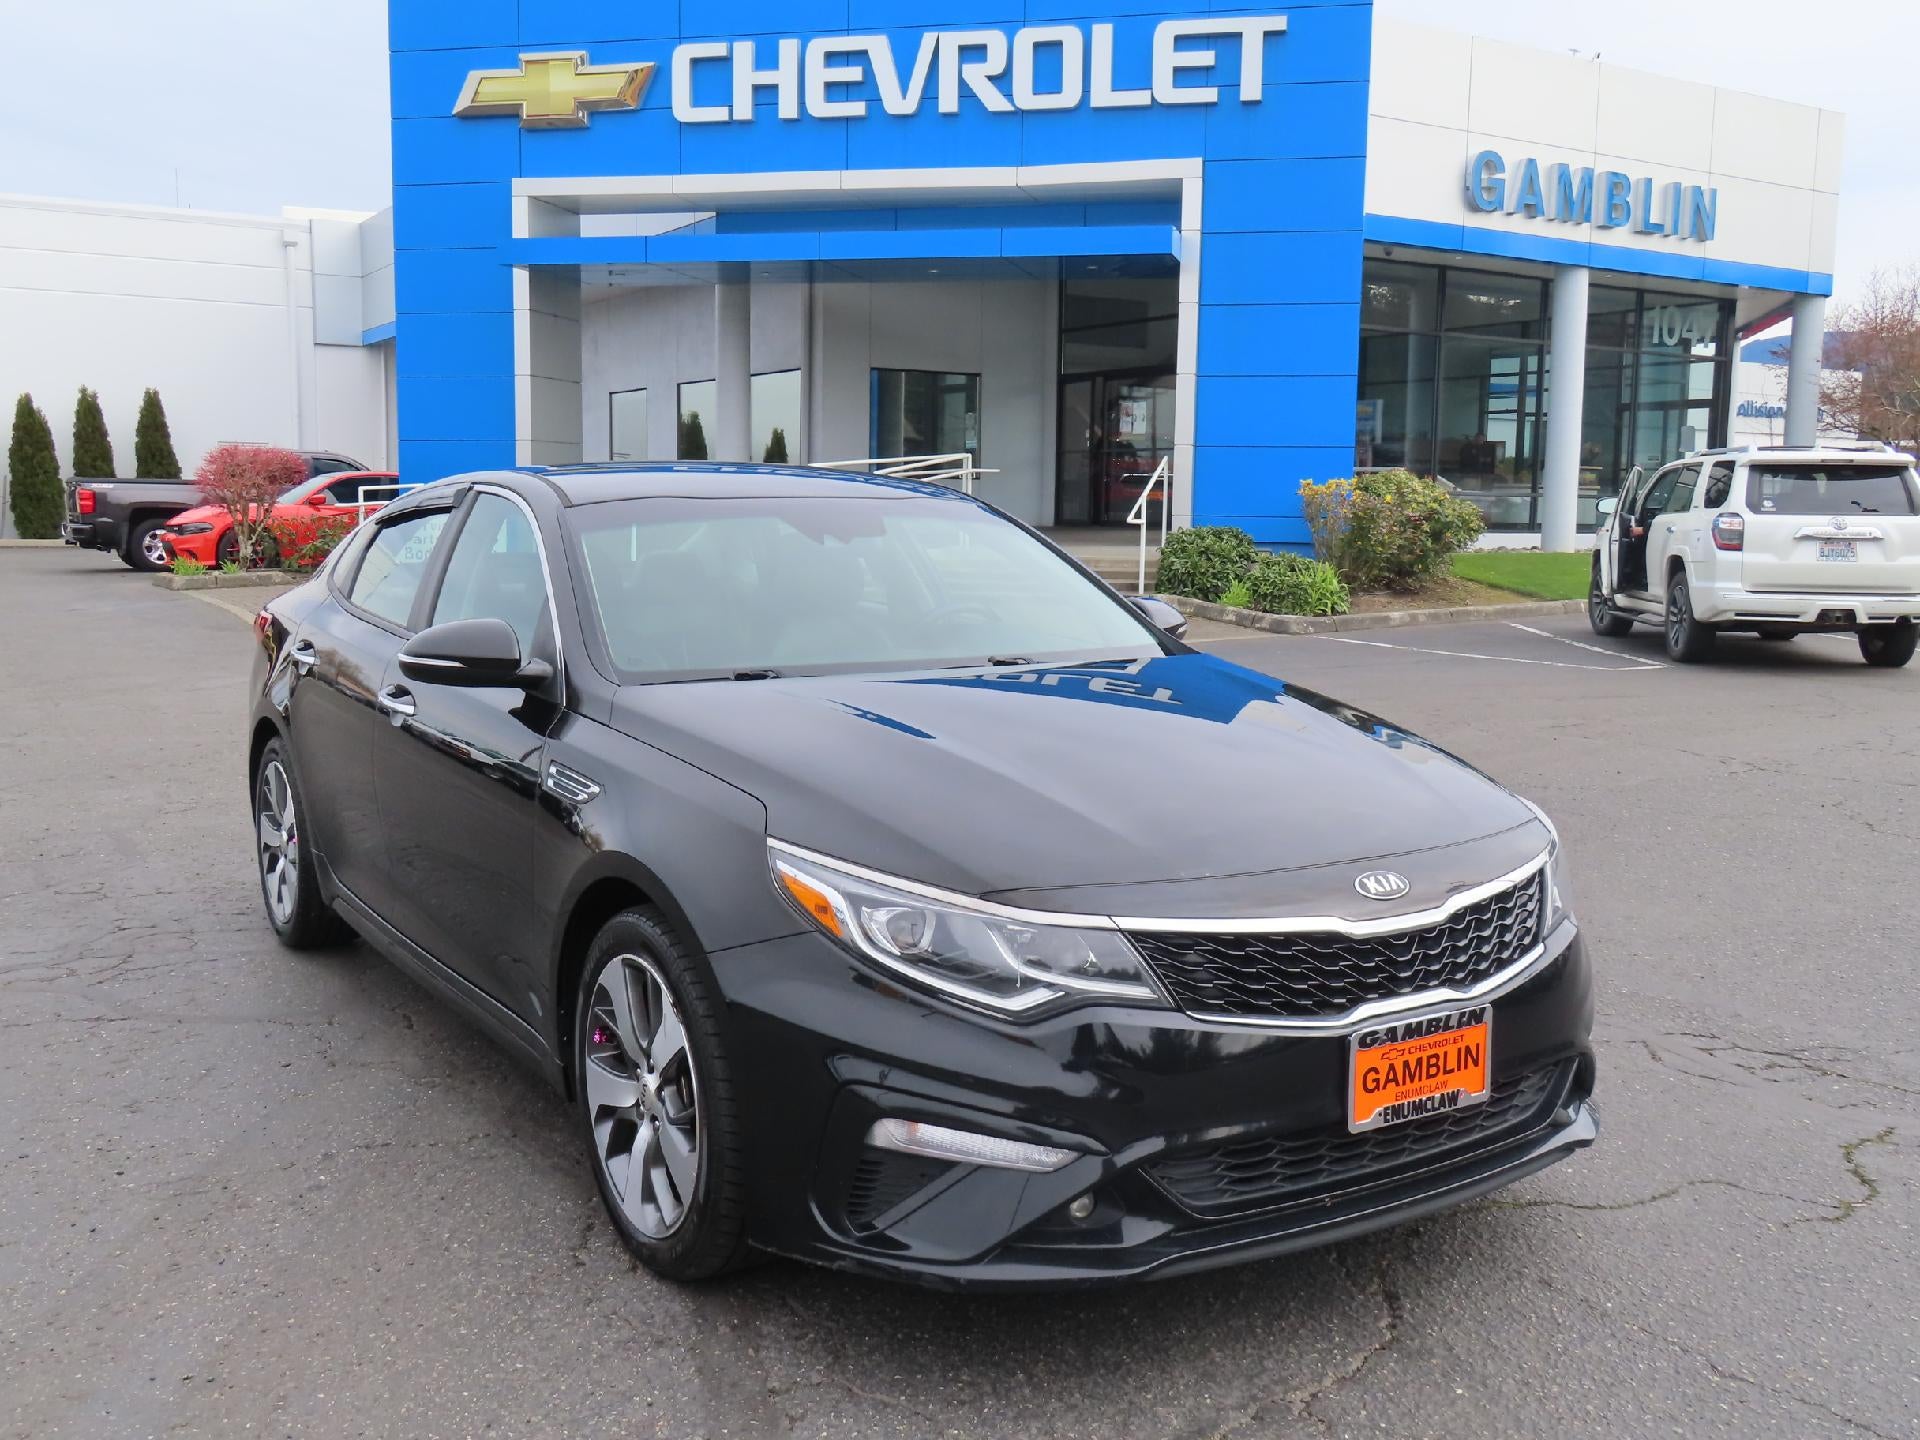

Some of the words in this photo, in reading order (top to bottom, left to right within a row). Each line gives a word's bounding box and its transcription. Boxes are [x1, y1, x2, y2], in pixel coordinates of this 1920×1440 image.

[671, 15, 1288, 123] CHEVROLET
[1466, 149, 1718, 242] GAMBLIN
[1360, 873, 1407, 895] KIA
[1357, 1006, 1487, 1050] GAMBLIN
[1407, 1033, 1465, 1056] CHEVROLET
[1362, 1042, 1480, 1094] GAMBLIN
[1382, 1091, 1460, 1124] ENUMCLAW
[1395, 1079, 1450, 1102] ENUMCLAW
